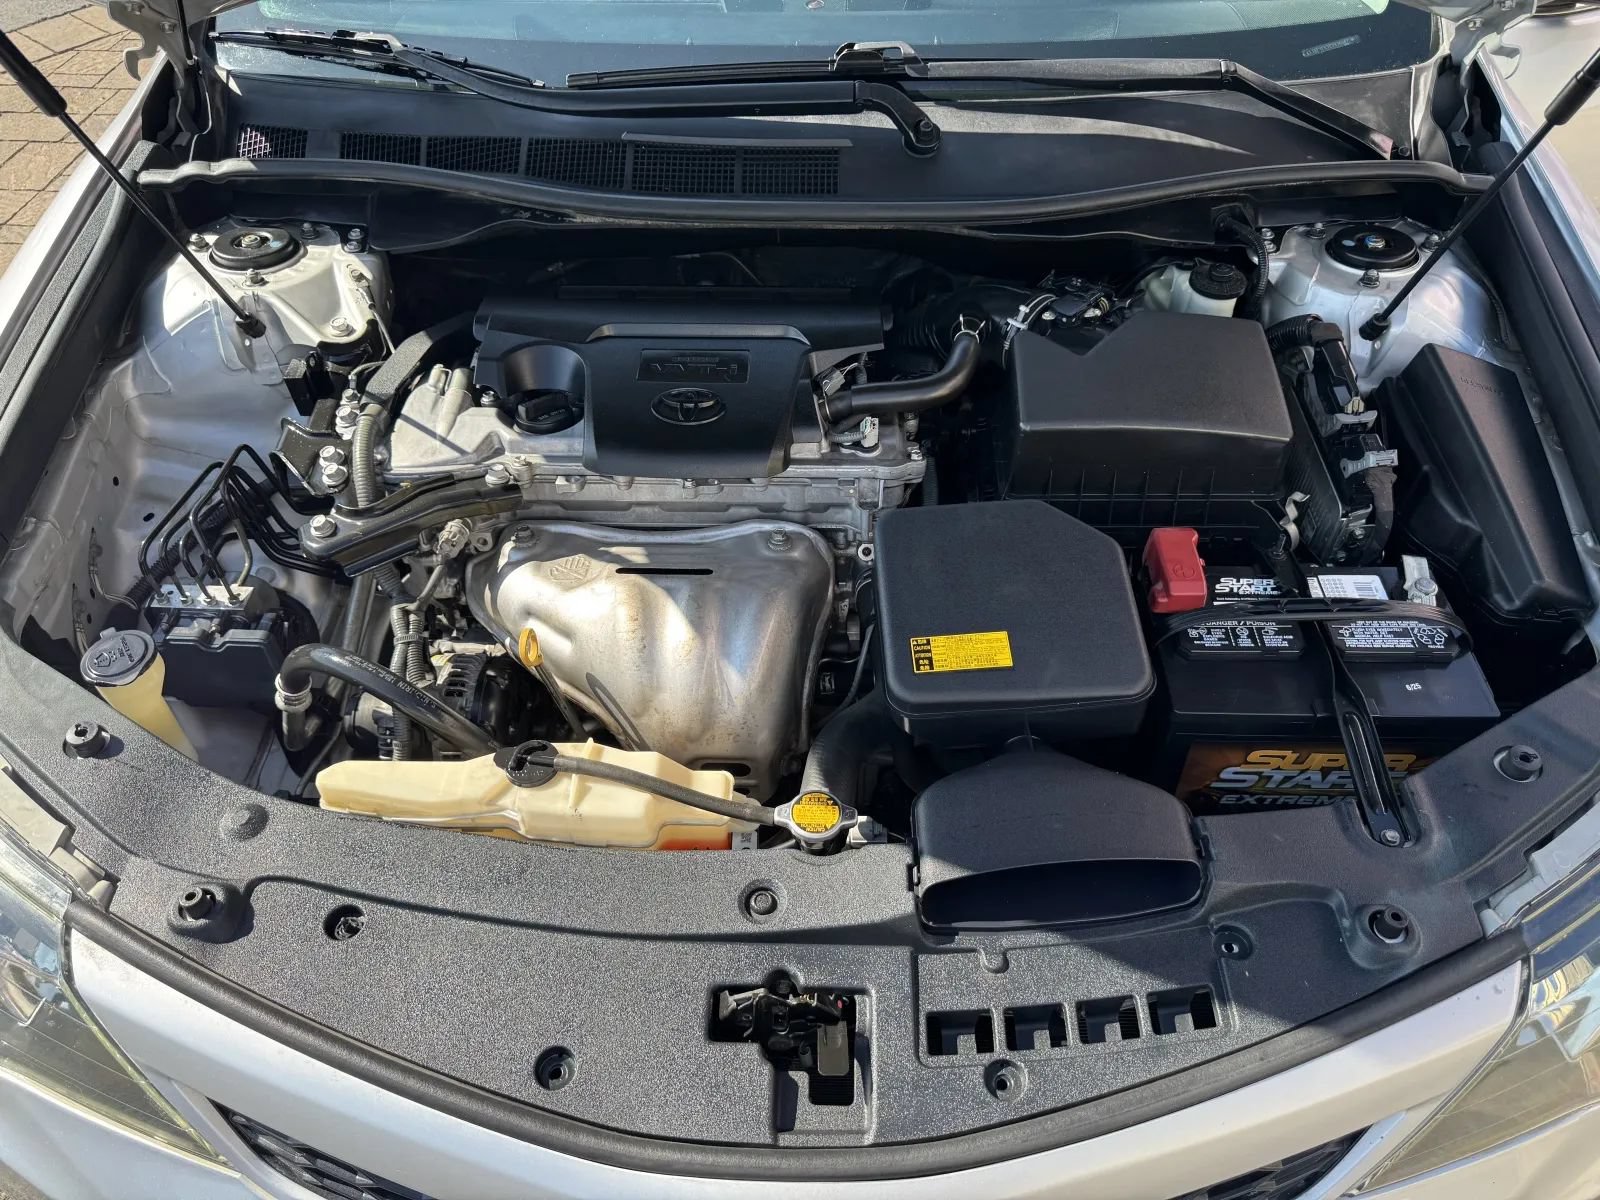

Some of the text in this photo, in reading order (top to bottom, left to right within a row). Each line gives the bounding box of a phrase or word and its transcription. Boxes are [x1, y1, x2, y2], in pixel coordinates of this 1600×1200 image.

[1220, 577, 1274, 585] SUPER
[1215, 583, 1277, 593] START
[1240, 749, 1417, 771] SUPR
[1219, 794, 1358, 805] EXTREM
